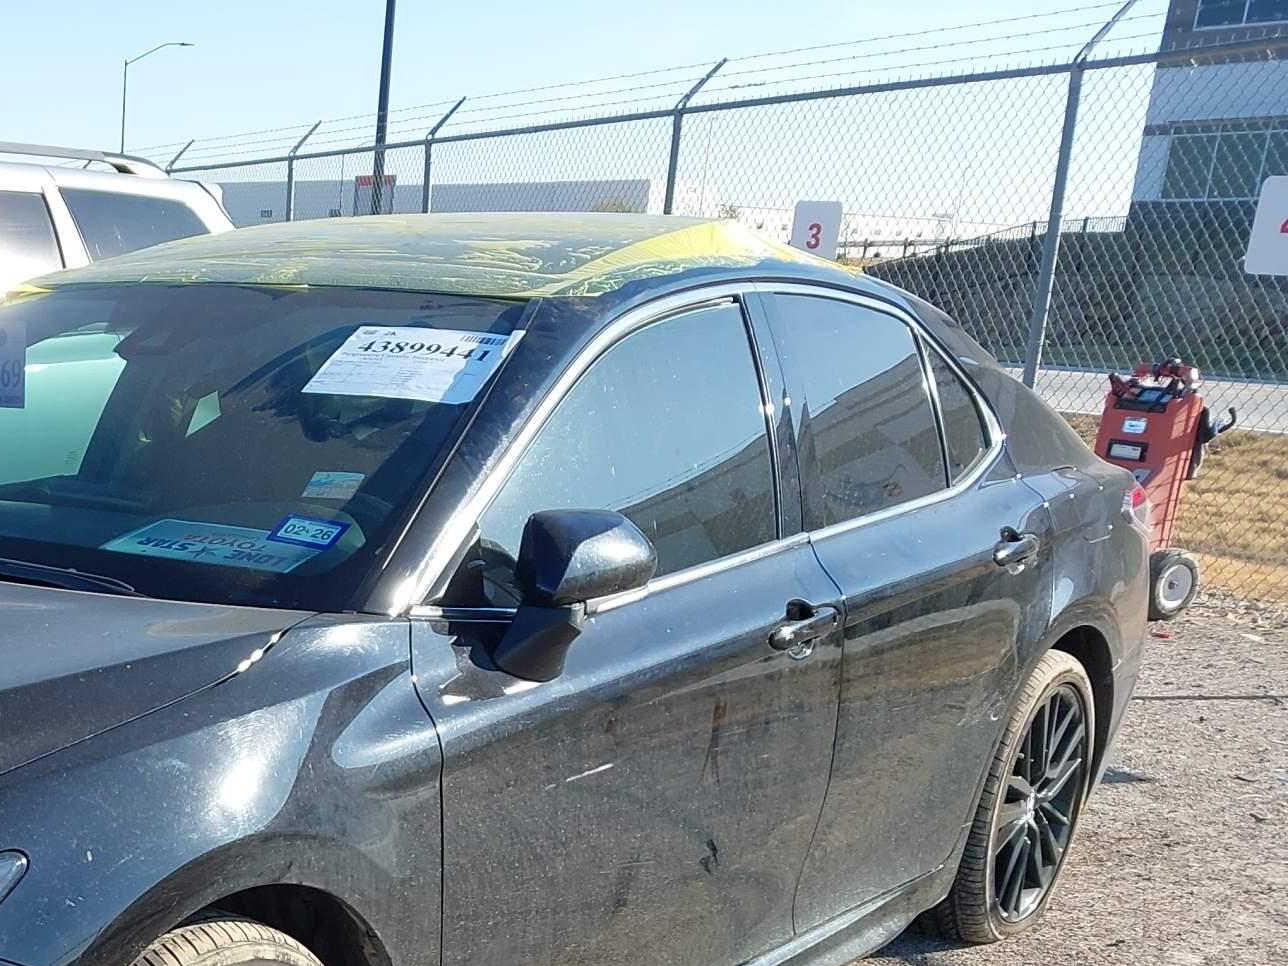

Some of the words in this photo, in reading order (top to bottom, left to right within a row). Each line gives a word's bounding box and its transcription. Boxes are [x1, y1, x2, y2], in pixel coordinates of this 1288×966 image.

[806, 222, 822, 249] 3
[356, 340, 491, 362] 43899441
[284, 523, 306, 536] 02
[309, 528, 334, 541] 26
[136, 536, 195, 552] STAR
[223, 549, 288, 567] LONE
